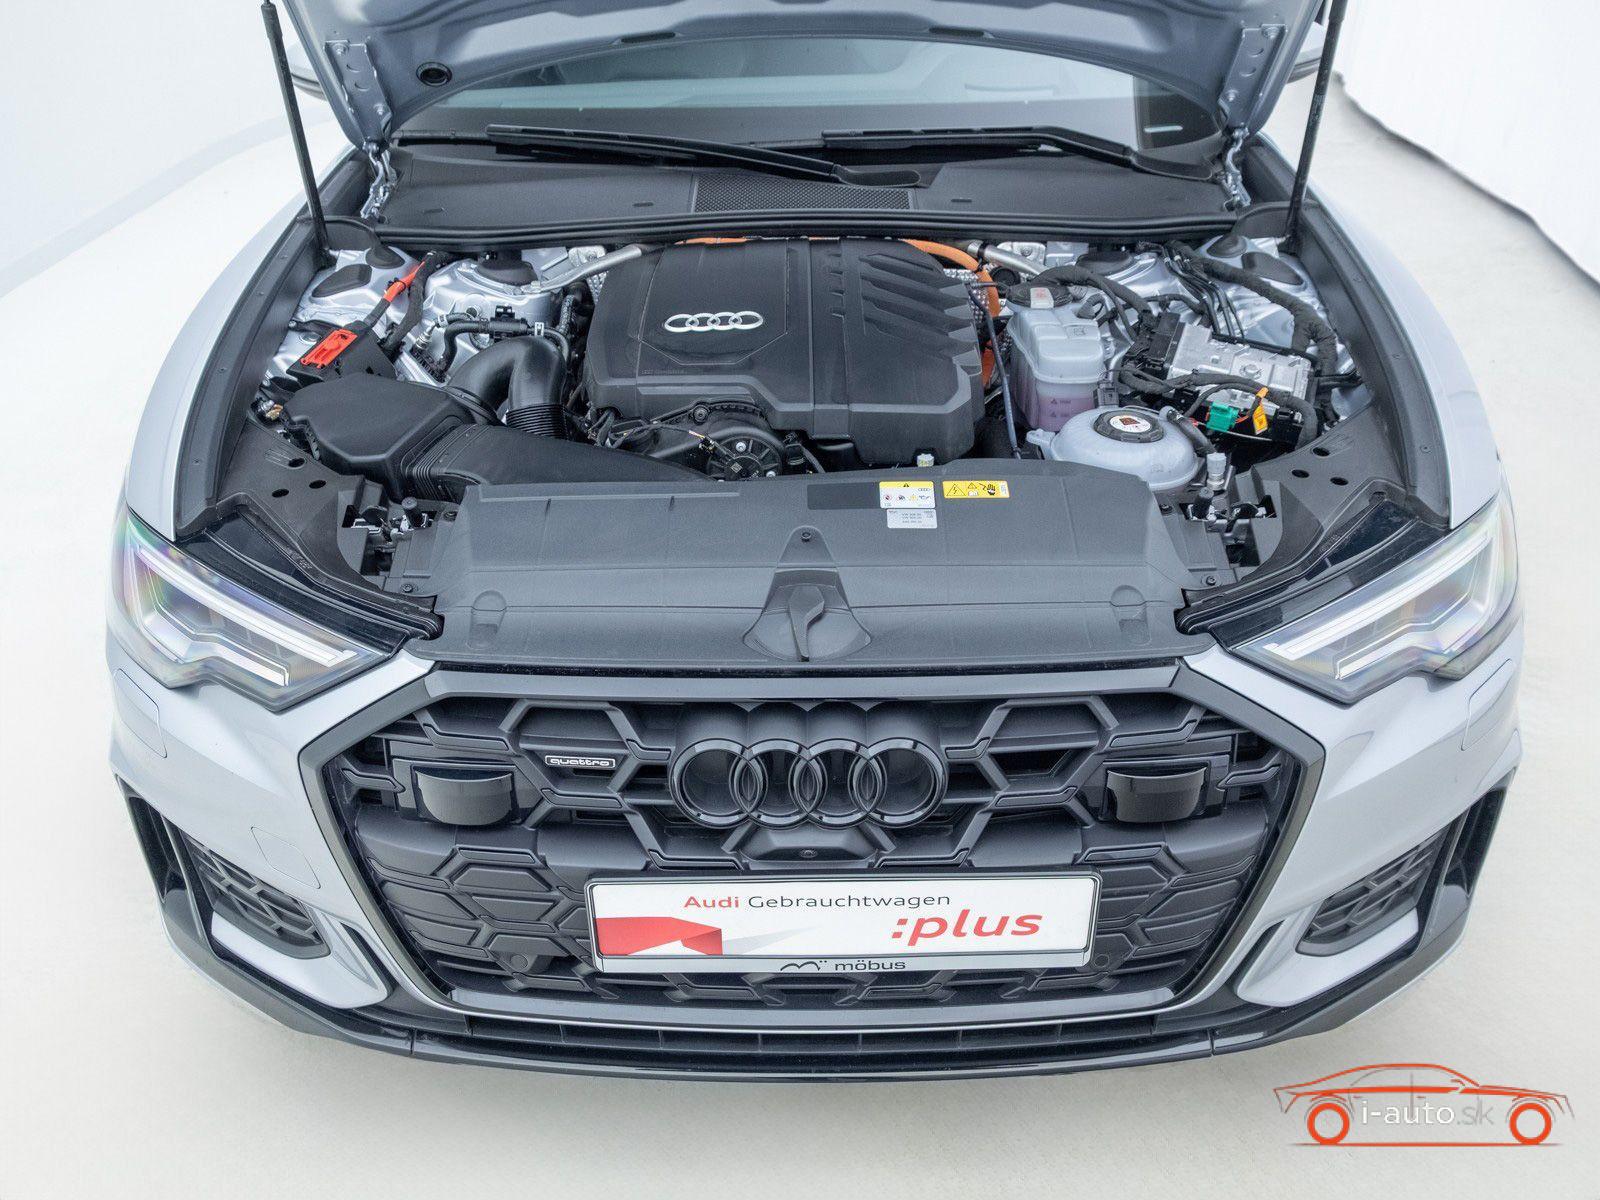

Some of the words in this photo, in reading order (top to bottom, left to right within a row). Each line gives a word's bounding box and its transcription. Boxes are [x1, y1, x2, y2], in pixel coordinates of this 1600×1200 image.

[550, 758, 610, 767] quattro
[684, 895, 739, 908] Audi
[748, 895, 951, 910] Gebrauchtwagen
[834, 960, 906, 972] möbus
